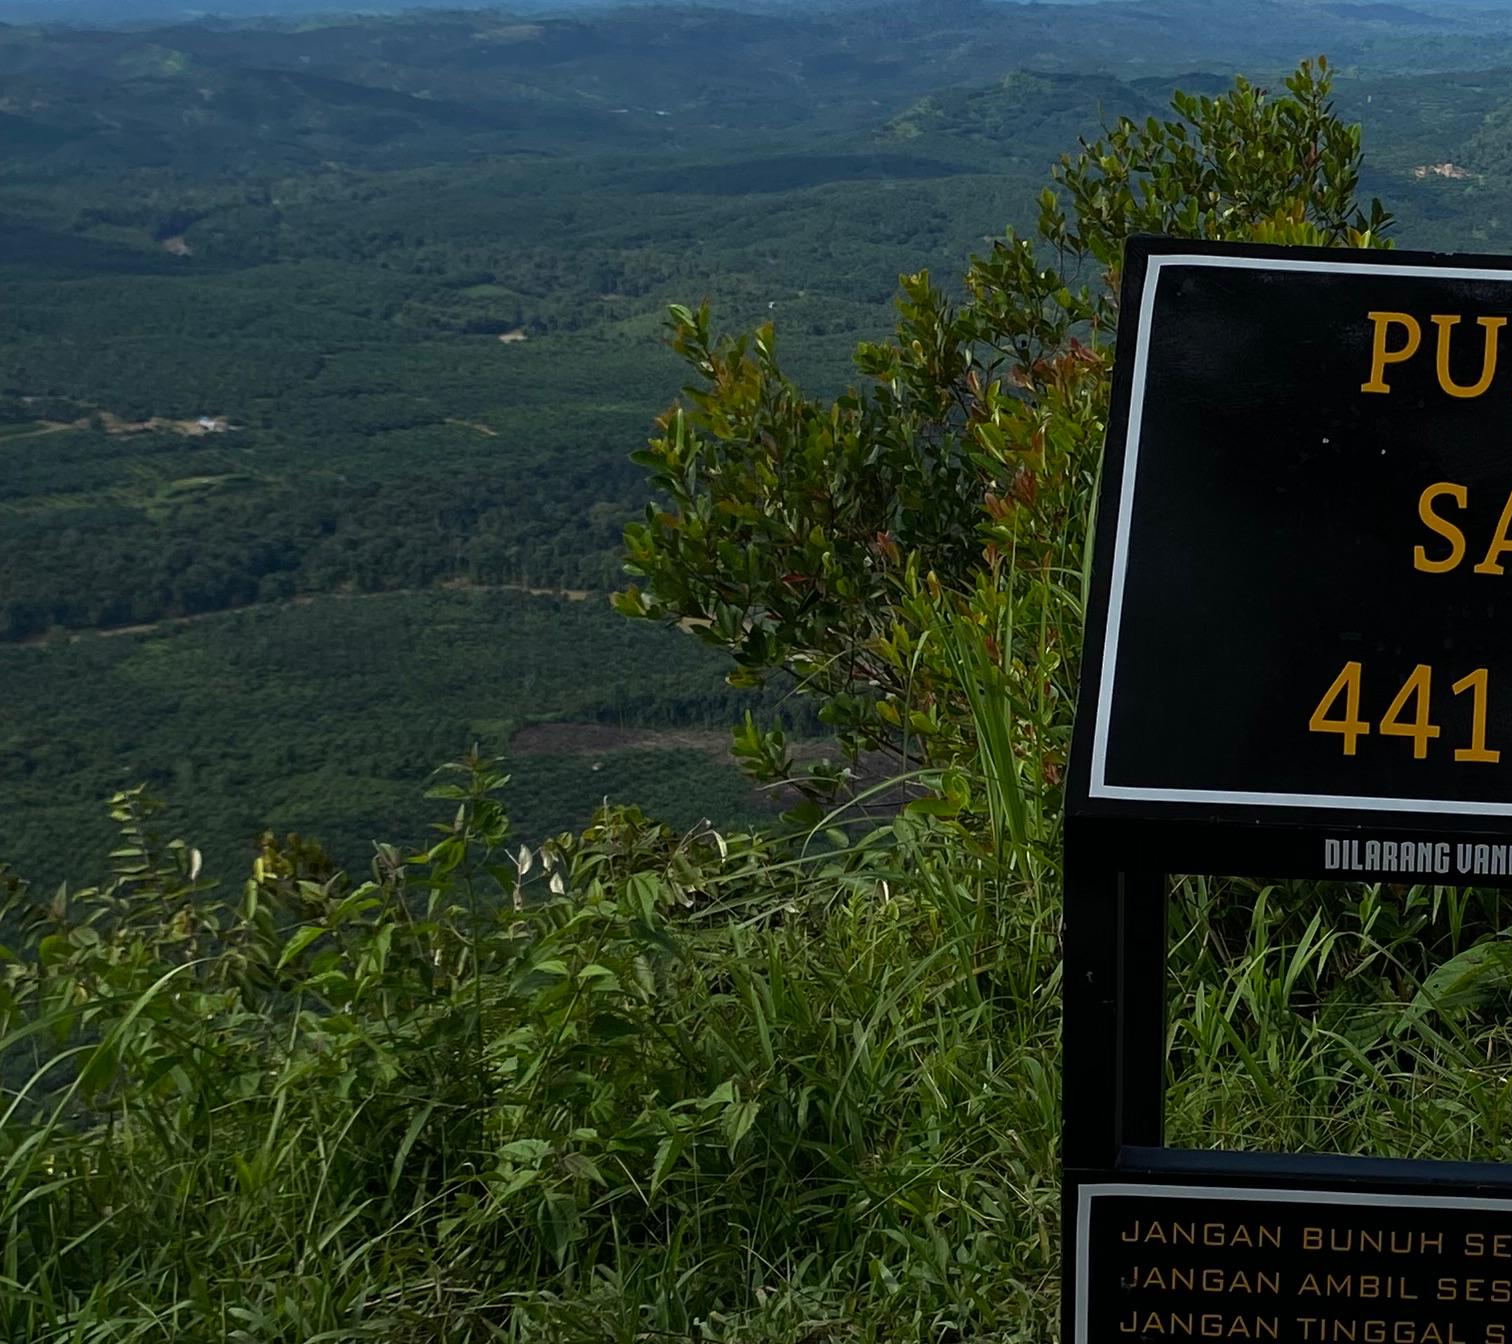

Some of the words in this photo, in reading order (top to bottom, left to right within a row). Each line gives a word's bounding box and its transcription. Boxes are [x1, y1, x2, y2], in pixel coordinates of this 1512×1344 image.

[1309, 661, 1500, 763] 441
[1326, 839, 1449, 873] DILARANG
[1122, 1221, 1281, 1248] JANGAN
[1303, 1228, 1442, 1253] BUNUH
[1122, 1267, 1279, 1294] JANGAN
[1298, 1274, 1418, 1299] AMBIL
[1120, 1311, 1278, 1338] JANGAN
[1297, 1318, 1465, 1344] TINGGAL
